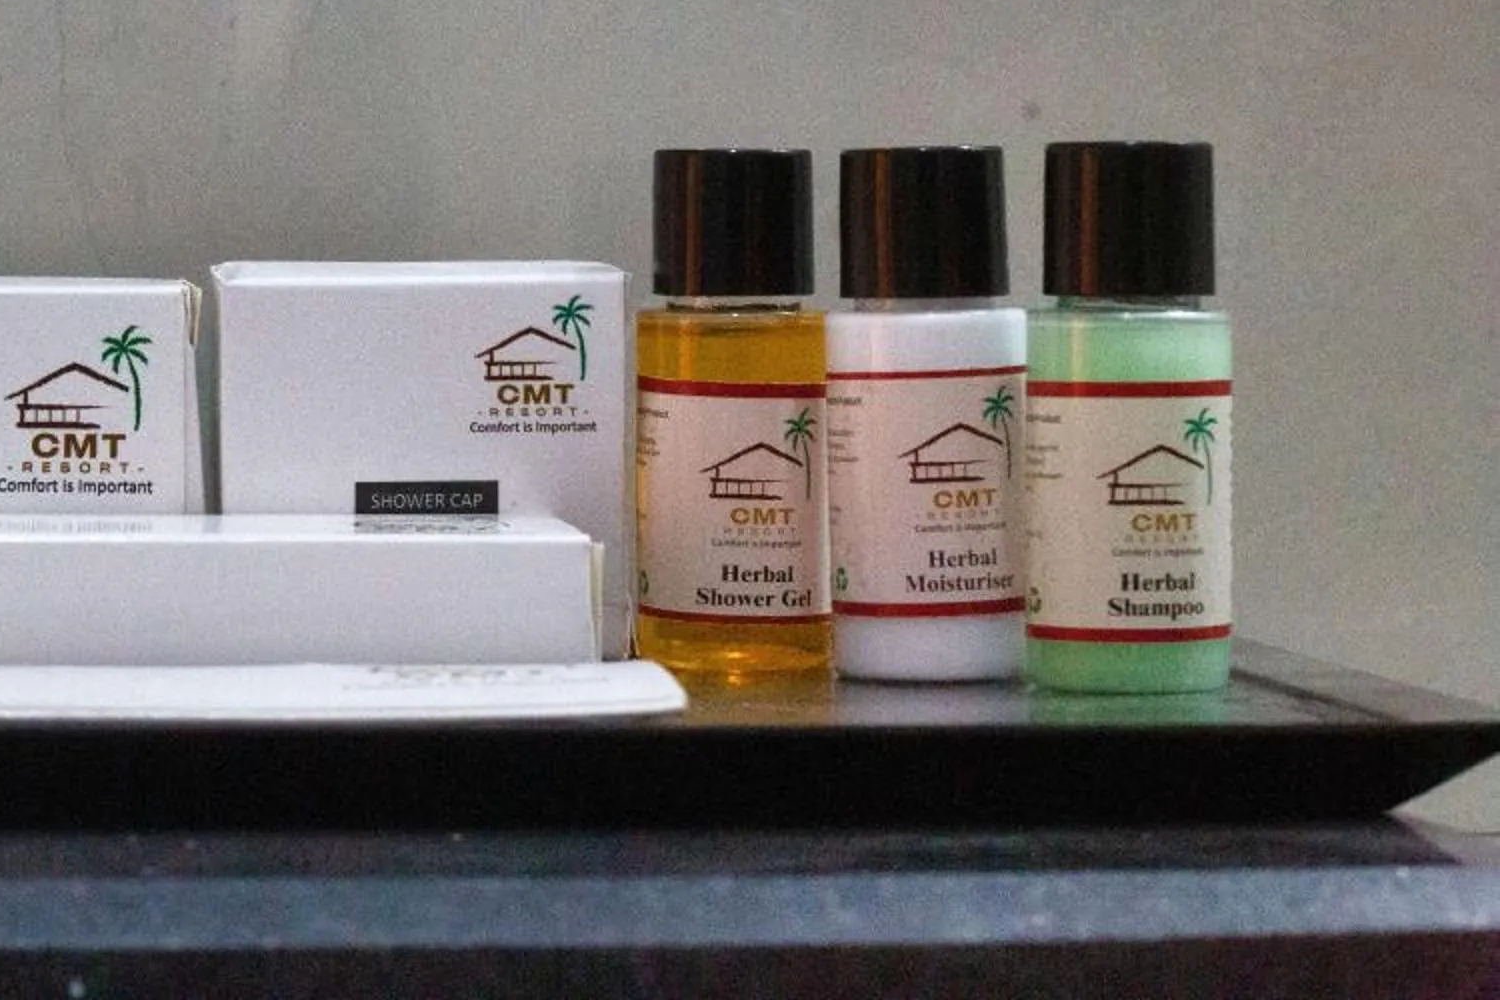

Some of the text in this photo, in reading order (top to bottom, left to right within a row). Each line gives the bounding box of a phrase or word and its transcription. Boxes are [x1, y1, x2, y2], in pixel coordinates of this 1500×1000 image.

[496, 384, 575, 405] CMT
[469, 421, 597, 437] Comfort is Important
[31, 433, 127, 459] CMT
[62, 479, 74, 493] is
[78, 479, 153, 496] Important
[371, 492, 484, 509] SHOWER CAP
[933, 487, 997, 509] CMT
[729, 507, 795, 525] CMT
[1132, 513, 1196, 533] CMT
[928, 547, 998, 568] Herbal
[721, 564, 794, 582] Herbal
[905, 572, 1015, 593] Moisturiser
[1121, 571, 1196, 592] Herbal
[695, 587, 812, 607] Shower Gel
[1107, 597, 1205, 621] Shampoo
